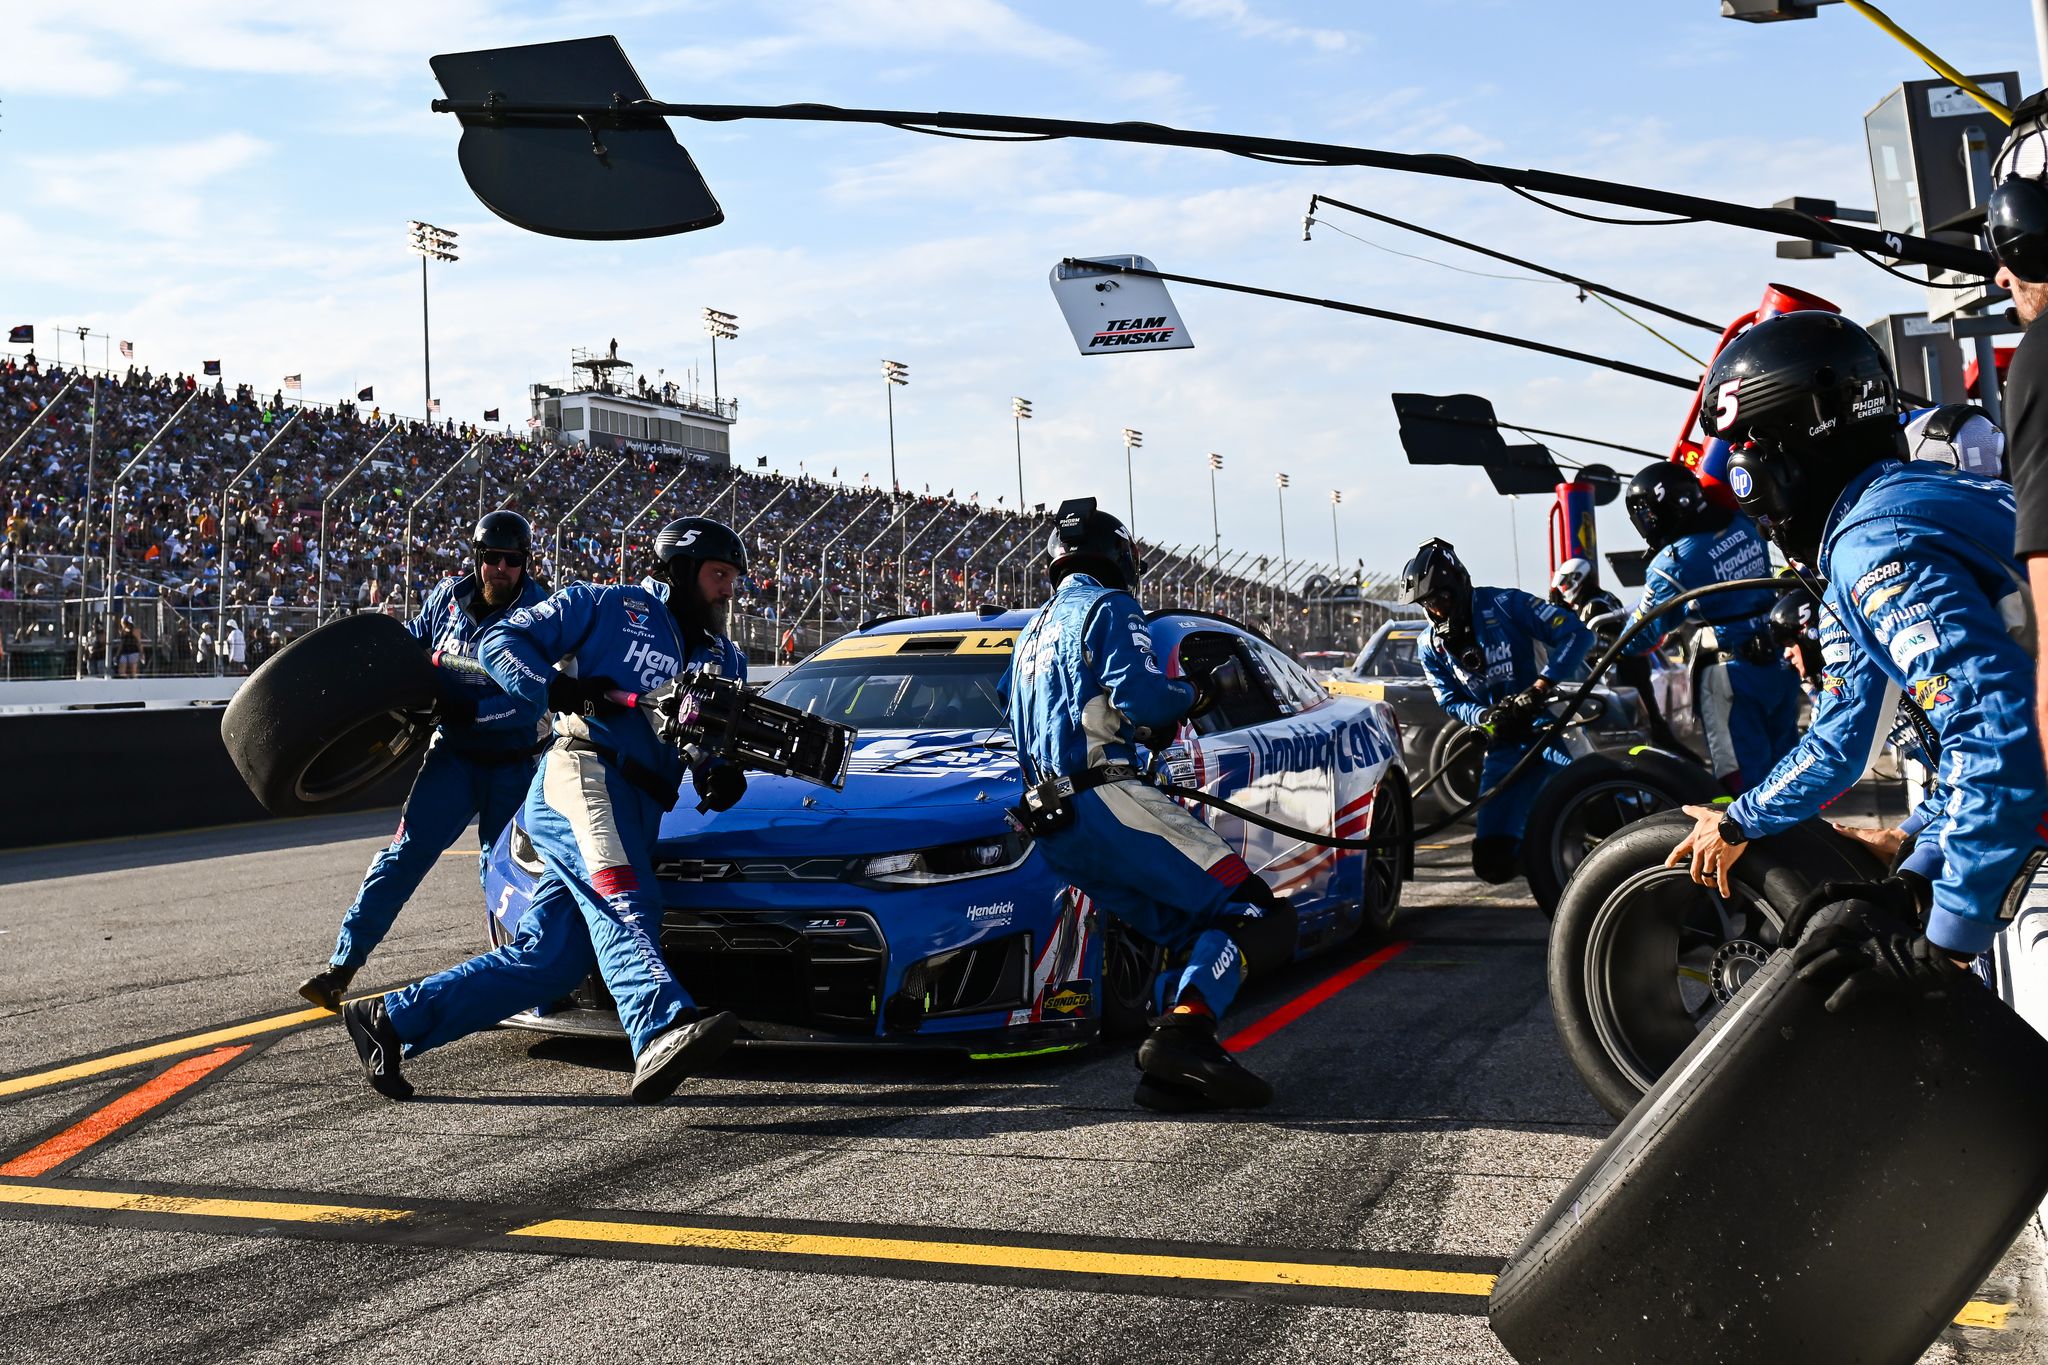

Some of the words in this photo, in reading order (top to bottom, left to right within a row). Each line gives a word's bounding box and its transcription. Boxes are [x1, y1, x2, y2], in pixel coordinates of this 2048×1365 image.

[1886, 233, 1903, 253] 5
[1107, 316, 1167, 331] TEAM
[1089, 331, 1174, 347] PENSKE
[1716, 377, 1743, 432] 5
[1852, 396, 1886, 412] PHORM
[1857, 406, 1885, 419] ENERGY
[1809, 417, 1837, 437] Caskey
[1654, 482, 1665, 502] 5
[1732, 467, 1749, 497] hp
[675, 530, 702, 546] 5
[1707, 530, 1748, 559] HARDER
[1713, 540, 1763, 580] Hendrick
[1855, 561, 1901, 597] NASCAR
[1798, 603, 1812, 624] 5
[622, 627, 656, 639] GOODYEAR
[496, 885, 515, 917] 5
[966, 901, 1014, 921] Hendrick
[806, 919, 847, 928] ZL1
[1045, 995, 1088, 1008] SUNOCO
